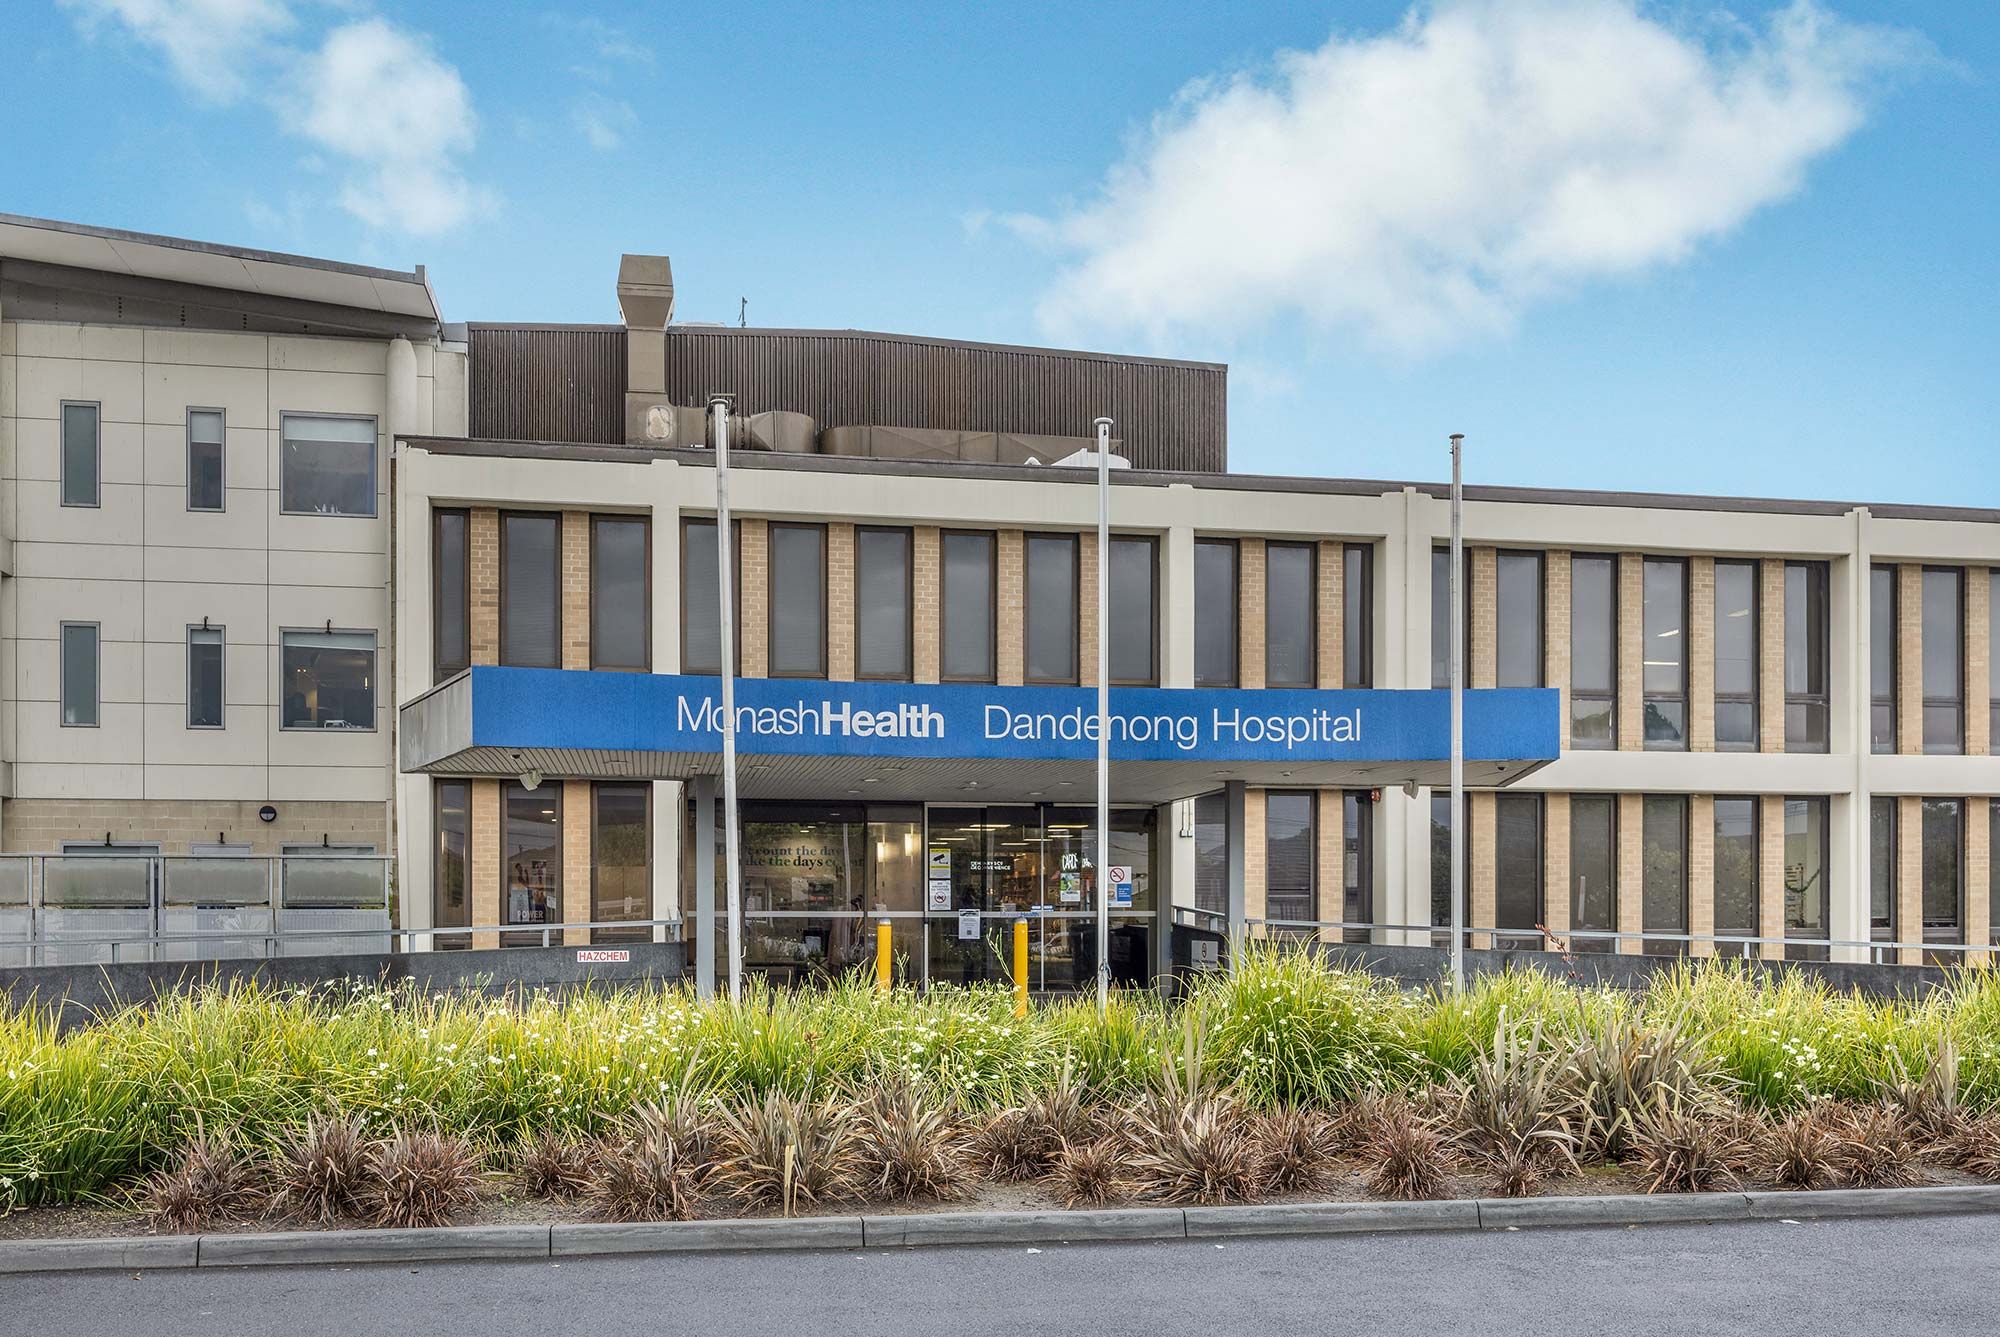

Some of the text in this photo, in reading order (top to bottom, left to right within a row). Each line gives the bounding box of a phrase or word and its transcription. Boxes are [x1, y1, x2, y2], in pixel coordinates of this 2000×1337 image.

[984, 704, 1198, 750] Dandenong
[1213, 708, 1362, 750] Hospital
[797, 845, 817, 856] the
[768, 856, 791, 868] the
[793, 856, 824, 870] days
[579, 952, 628, 961] HAZCHEM
